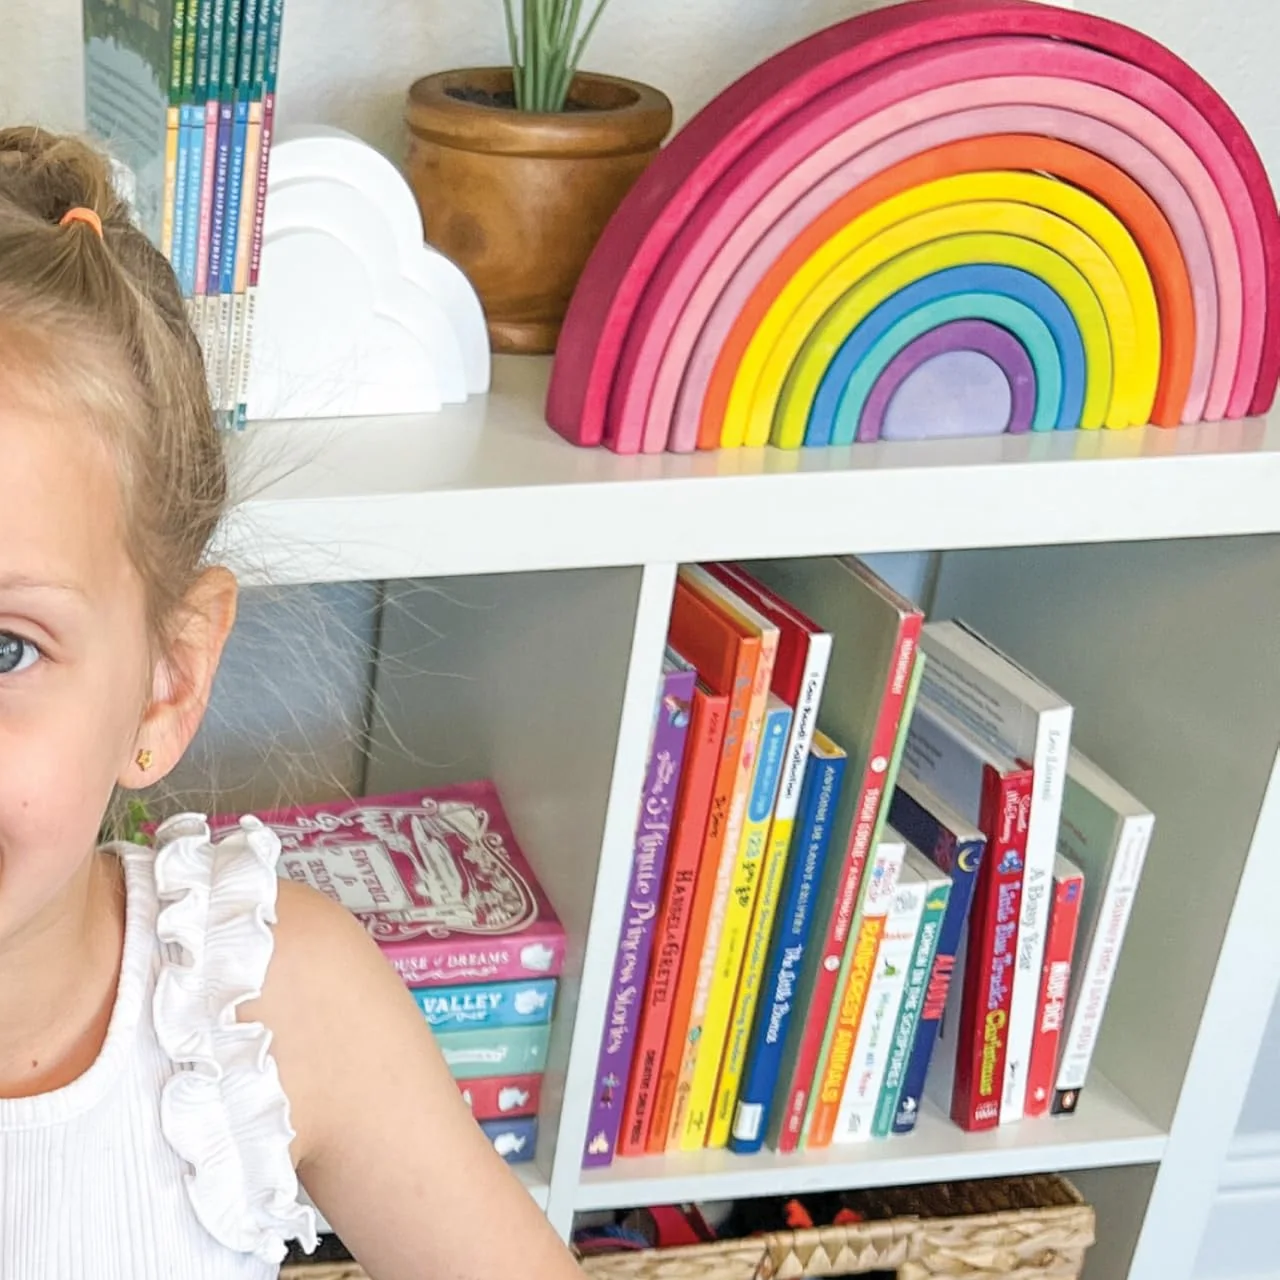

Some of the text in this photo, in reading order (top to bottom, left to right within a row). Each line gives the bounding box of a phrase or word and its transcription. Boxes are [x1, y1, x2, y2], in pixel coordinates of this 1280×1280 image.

[1030, 868, 1044, 882] A
[447, 951, 510, 968] DREAMS
[617, 900, 655, 983] Princess
[917, 921, 937, 966] WOMEN
[423, 992, 502, 1013] VALLEY
[653, 942, 680, 1007] GRETEL
[923, 954, 955, 1020] ALADDIN
[607, 986, 635, 1054] Stories
[822, 919, 880, 1101] RAINFOREST ANIMALS
